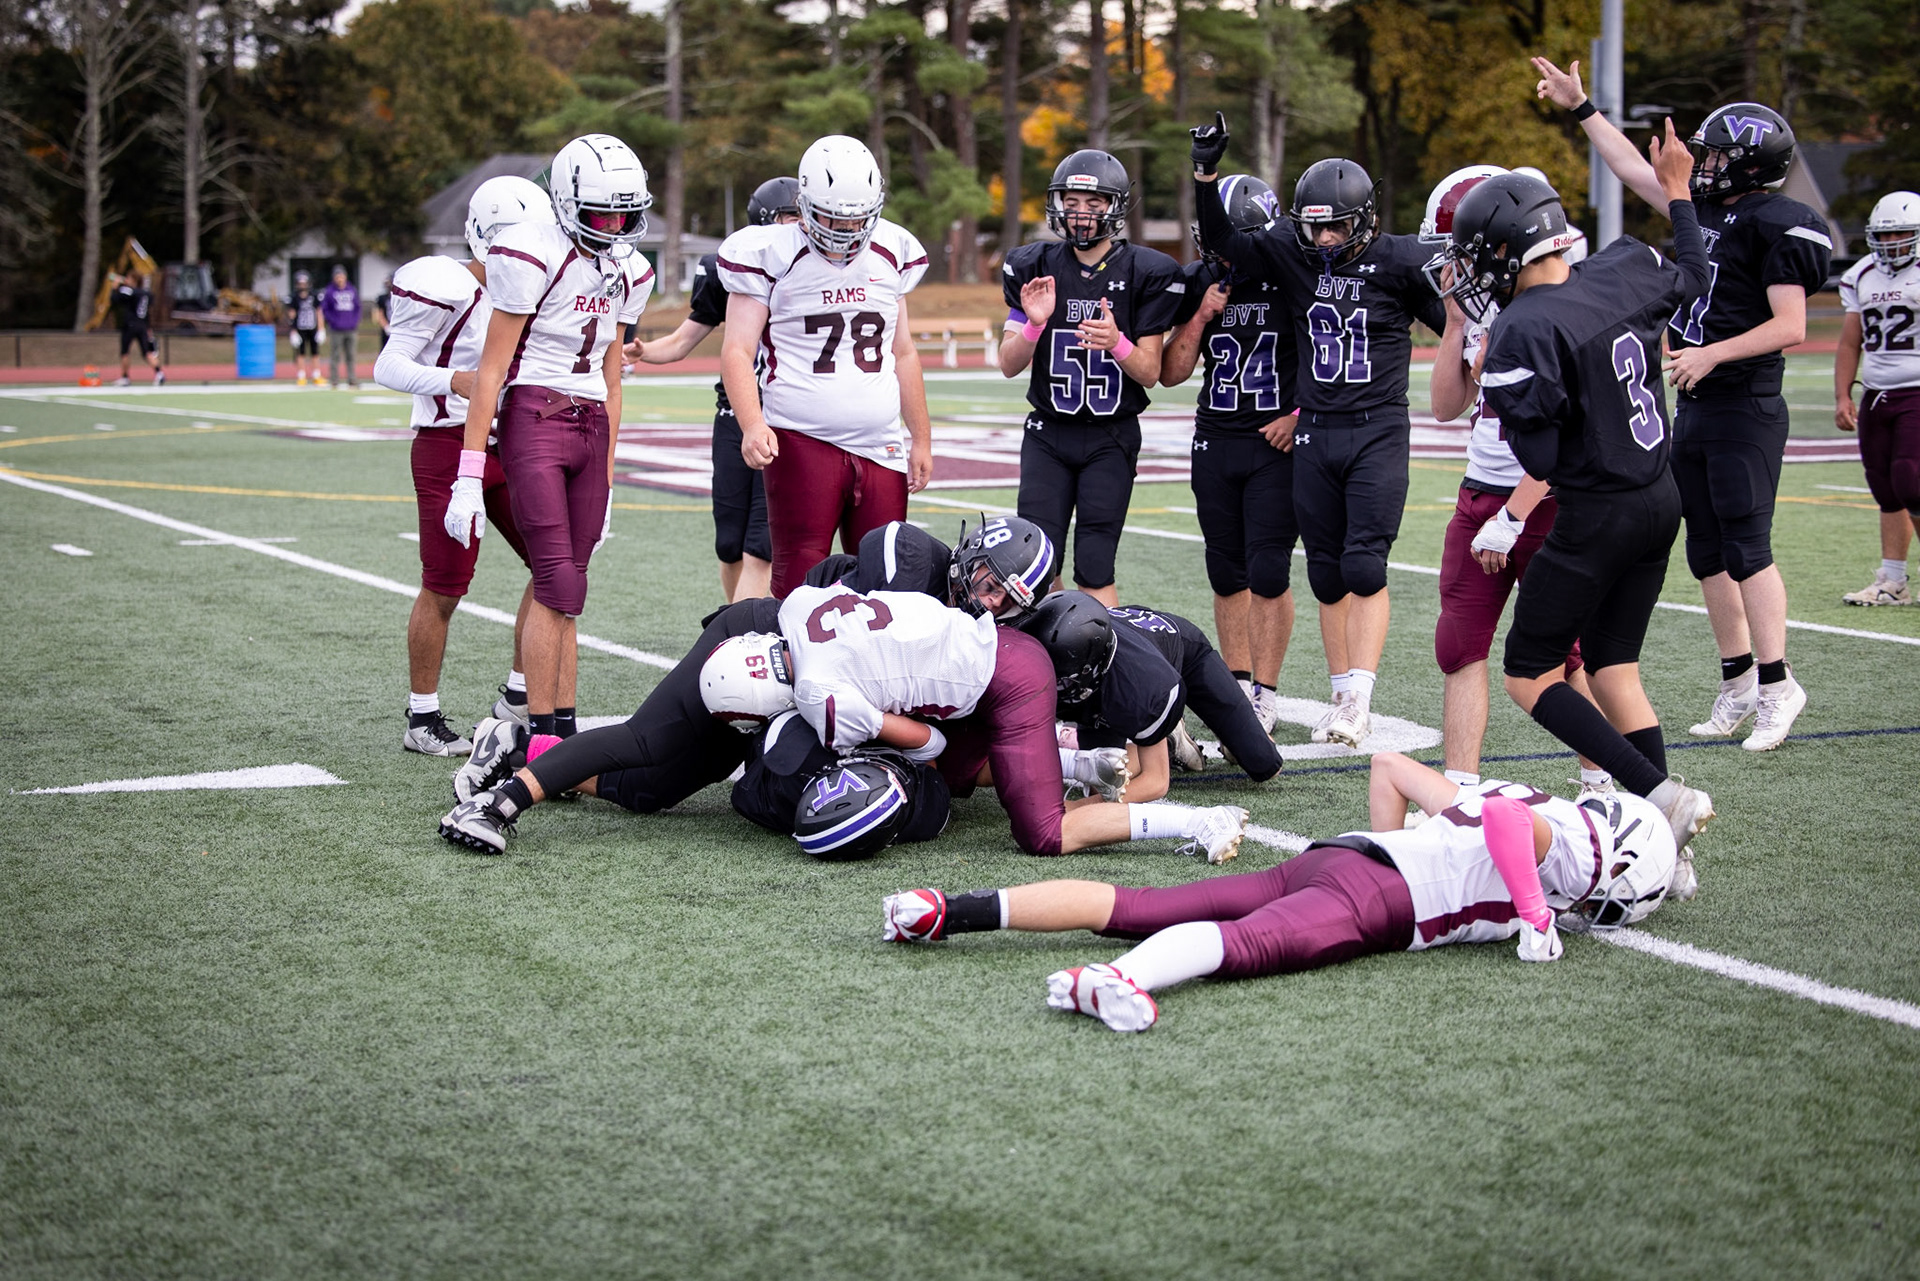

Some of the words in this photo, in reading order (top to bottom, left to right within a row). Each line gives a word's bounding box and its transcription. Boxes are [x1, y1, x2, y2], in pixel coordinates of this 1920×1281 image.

[1722, 114, 1774, 146] VT
[573, 294, 611, 314] RAMS
[821, 287, 866, 304] RAMS
[1315, 274, 1365, 301] BVT
[1871, 290, 1902, 303] RAMS
[1221, 303, 1270, 327] BVT
[571, 317, 599, 374] 1
[804, 311, 886, 374] 78
[1306, 301, 1372, 383] 81
[1049, 328, 1123, 416] 55
[1208, 331, 1281, 412] 24
[1611, 331, 1664, 452] 3
[805, 592, 894, 644] 3
[745, 654, 769, 680] 49
